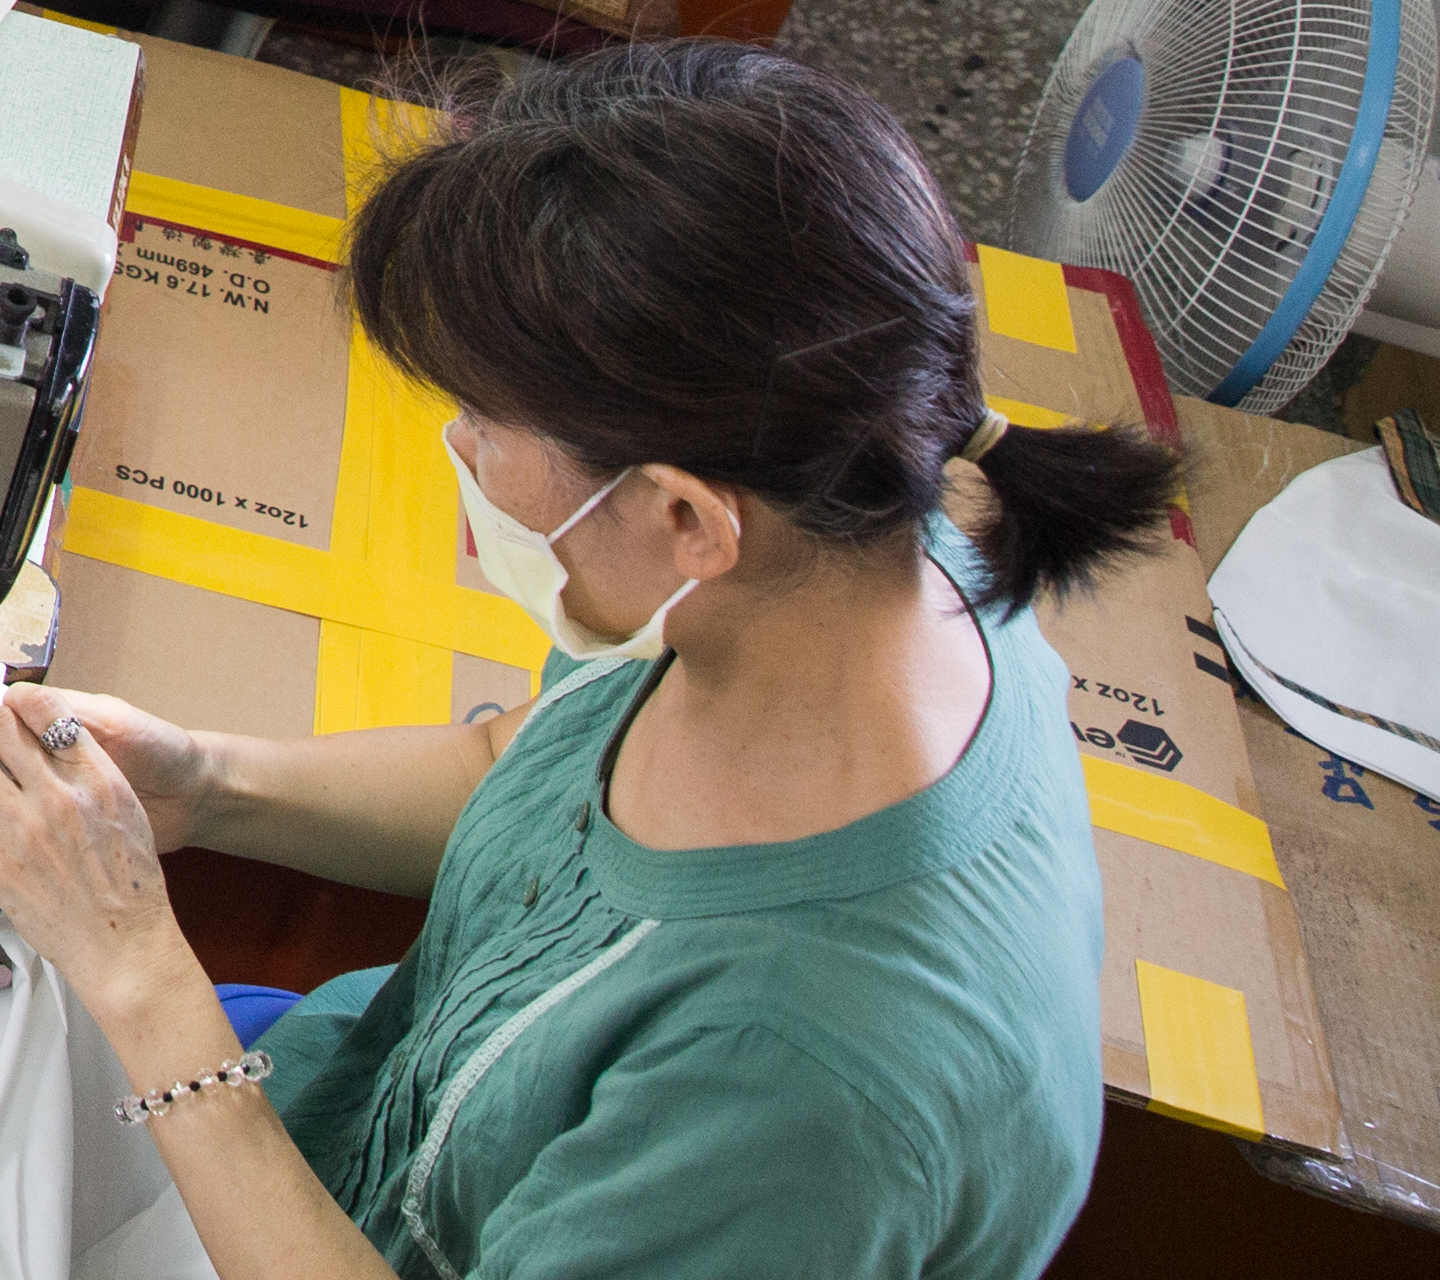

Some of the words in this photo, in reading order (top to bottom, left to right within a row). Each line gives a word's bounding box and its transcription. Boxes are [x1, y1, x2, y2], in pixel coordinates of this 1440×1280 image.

[114, 261, 159, 284] KGS
[137, 247, 213, 278] 469mm
[167, 275, 211, 297] 17.6
[223, 270, 270, 294] O.D.
[220, 288, 270, 314] N.W.
[115, 464, 165, 490] PCS
[172, 480, 225, 506] 1000
[234, 496, 248, 509] x
[255, 501, 309, 529] 12oz
[1072, 675, 1089, 692] x
[1096, 682, 1165, 716] 12oz
